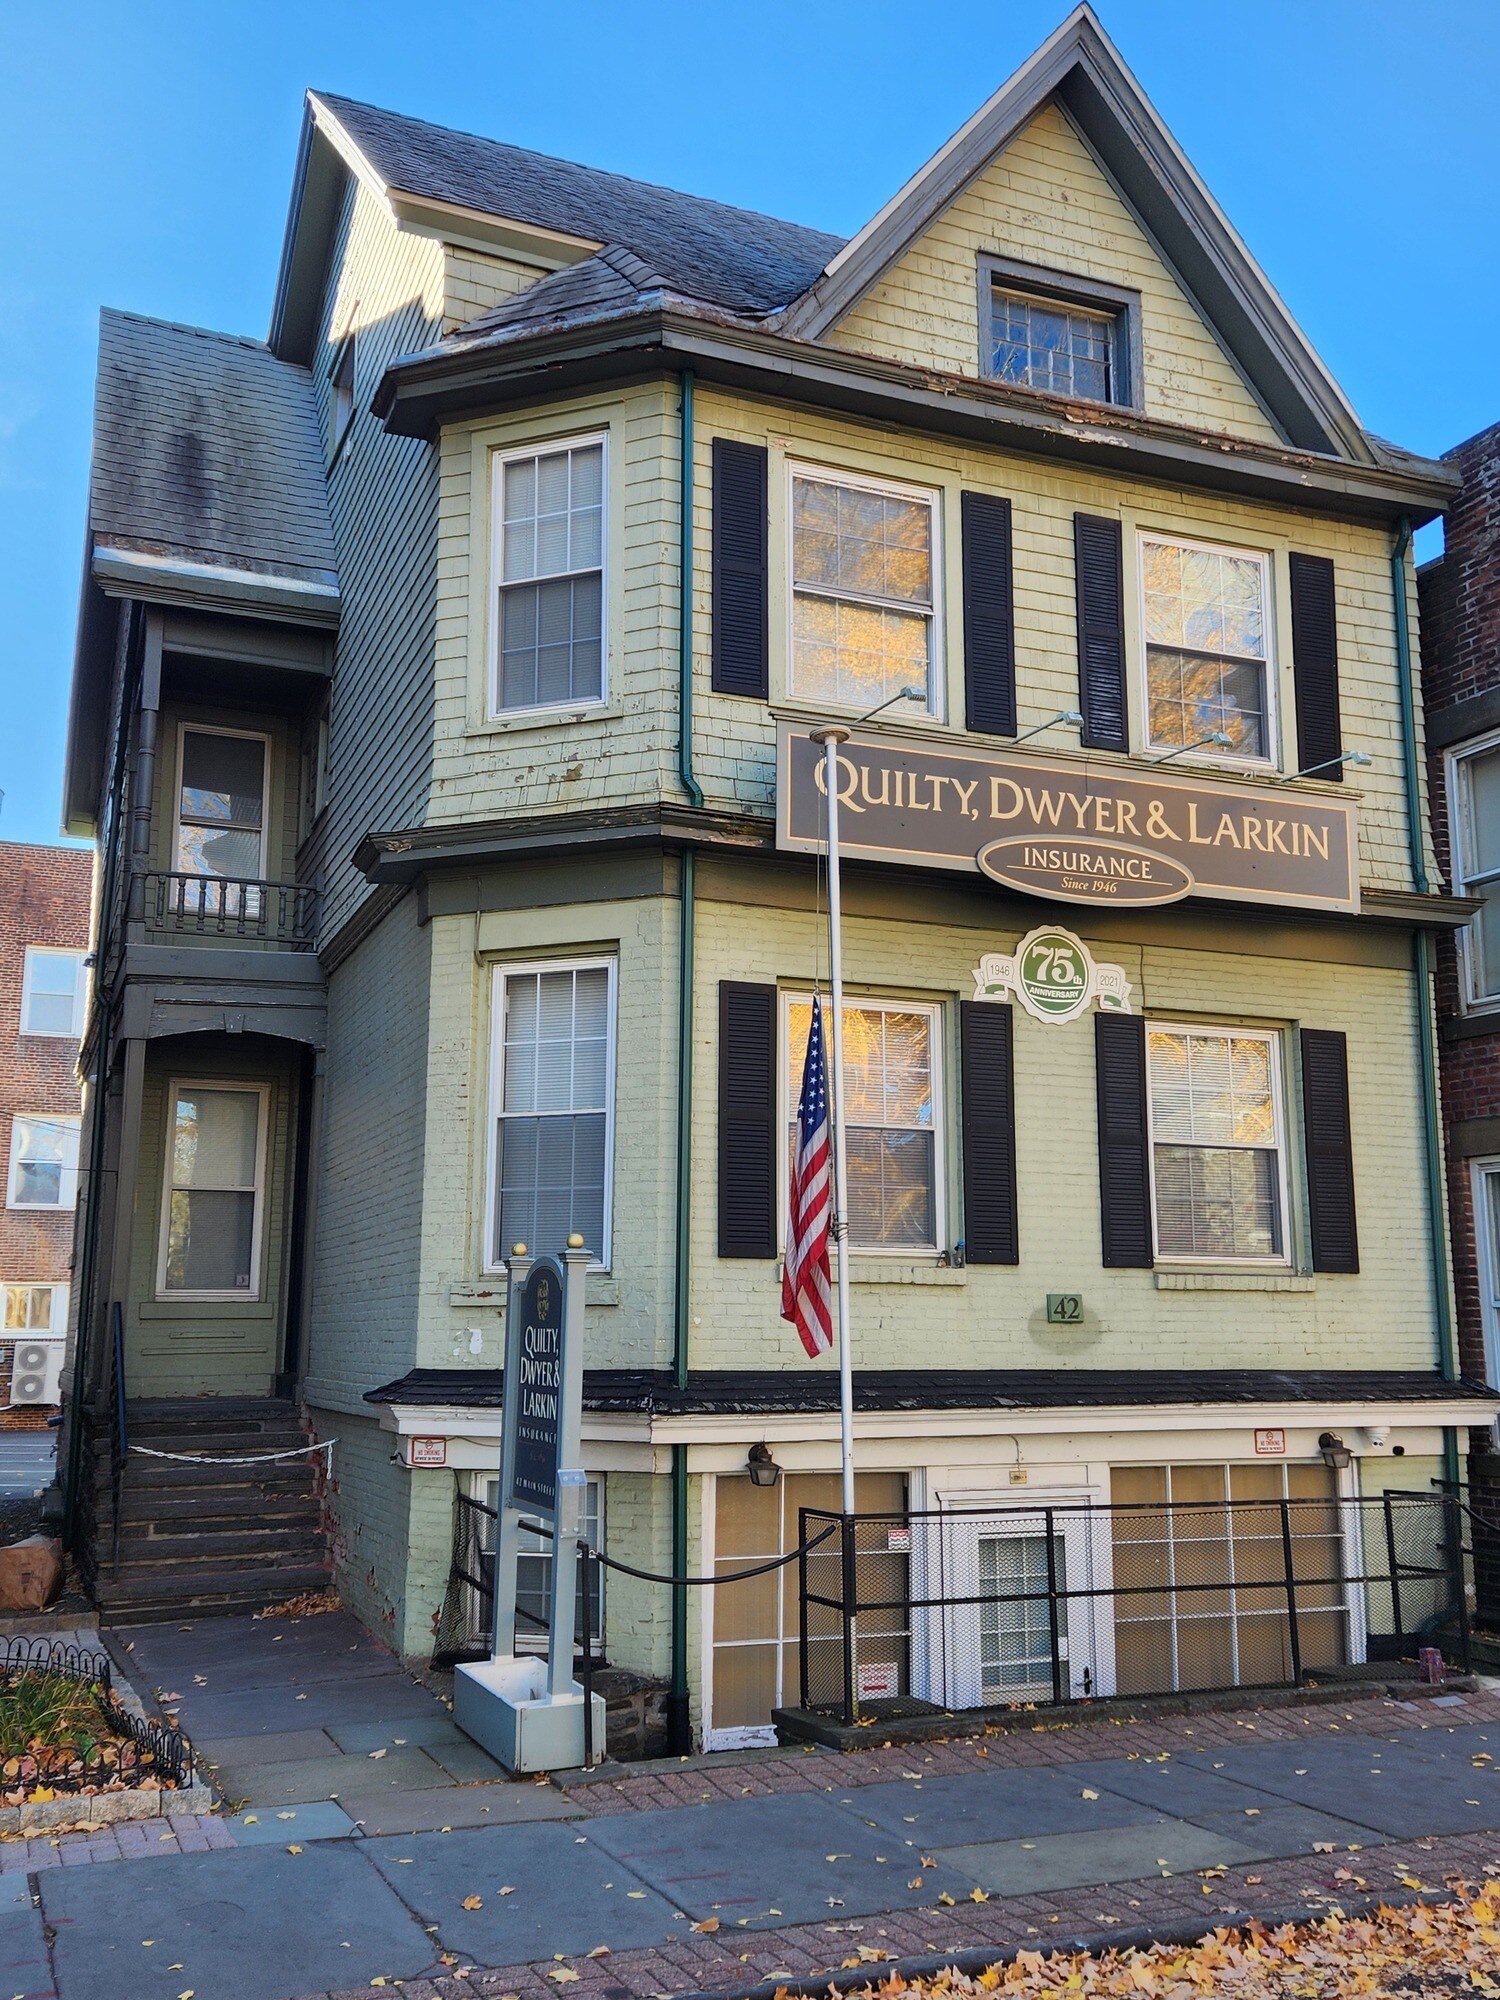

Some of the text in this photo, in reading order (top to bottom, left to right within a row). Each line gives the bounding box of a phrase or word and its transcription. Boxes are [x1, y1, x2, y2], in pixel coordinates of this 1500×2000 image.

[814, 755, 1330, 860] QUILTY, DWYER & LARKIN
[1024, 847, 1153, 879] INSURANCE
[1061, 877, 1119, 893] Since 1946
[990, 964, 1010, 976] 1946
[1100, 975, 1119, 987] 2021
[1029, 986, 1079, 999] ANNIVERSARY
[1053, 1296, 1080, 1320] 42
[525, 1325, 559, 1359] QUILTY,
[520, 1356, 560, 1388] DWYER &
[523, 1388, 558, 1421] LARKIN
[518, 1426, 557, 1445] INSURANCE
